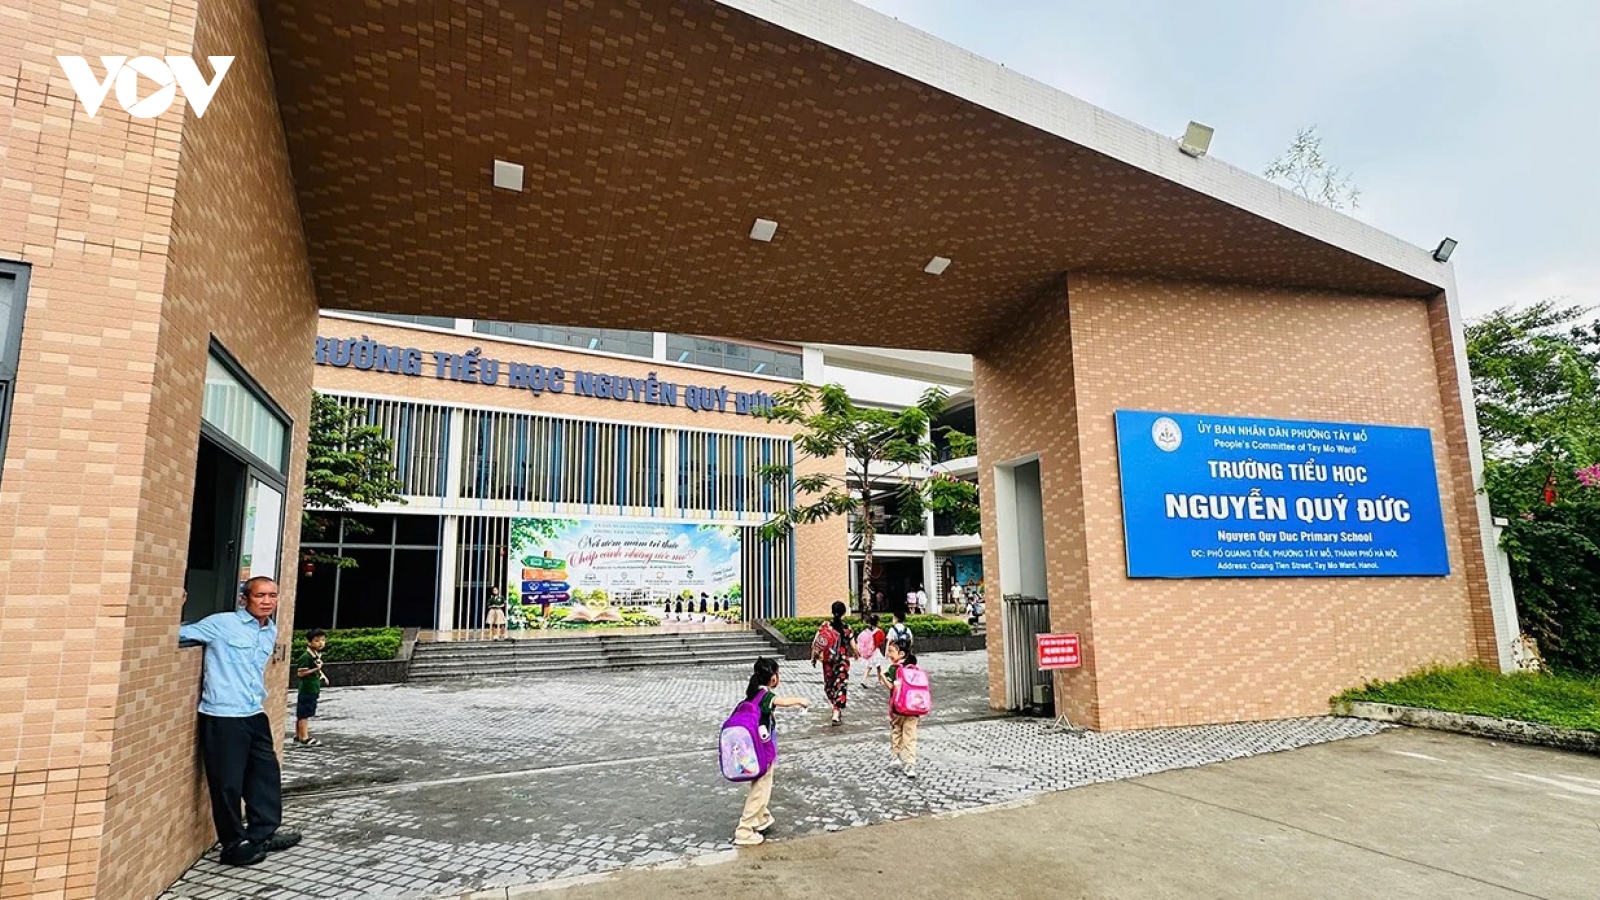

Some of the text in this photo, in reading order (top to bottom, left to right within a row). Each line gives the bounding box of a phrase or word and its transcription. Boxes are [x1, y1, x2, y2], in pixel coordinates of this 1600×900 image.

[315, 334, 422, 377] RƯỜNG
[433, 346, 499, 386] TIỂU
[508, 360, 565, 397] HỌC
[574, 371, 678, 407] NGUYỄN
[685, 385, 729, 412] QUÝ
[1197, 420, 1211, 433] ỦY
[1214, 424, 1235, 435] BAN
[1238, 423, 1266, 437] NHÂN
[1268, 425, 1289, 438] DÂN
[1291, 428, 1331, 440] PHƯỜNG
[1333, 428, 1350, 441] TÂY
[1214, 439, 1357, 455] People's Committee of Tay Mo Ward
[1207, 457, 1368, 486] TRƯỜNG TIỂU HỌC
[1164, 488, 1411, 523] NGUYỄN QUÝ ĐỨC
[1217, 530, 1373, 543] Nguyen Quy Duc Primary School
[1207, 546, 1223, 557] PHỐ
[1224, 549, 1251, 558] QUANG
[1273, 548, 1303, 558] PHƯỜNG
[1305, 548, 1318, 557] TÂY
[1358, 547, 1373, 557] PHỐ
[1217, 562, 1249, 570] Address:
[1250, 562, 1274, 571] Quang
[1314, 562, 1326, 571] Tay
